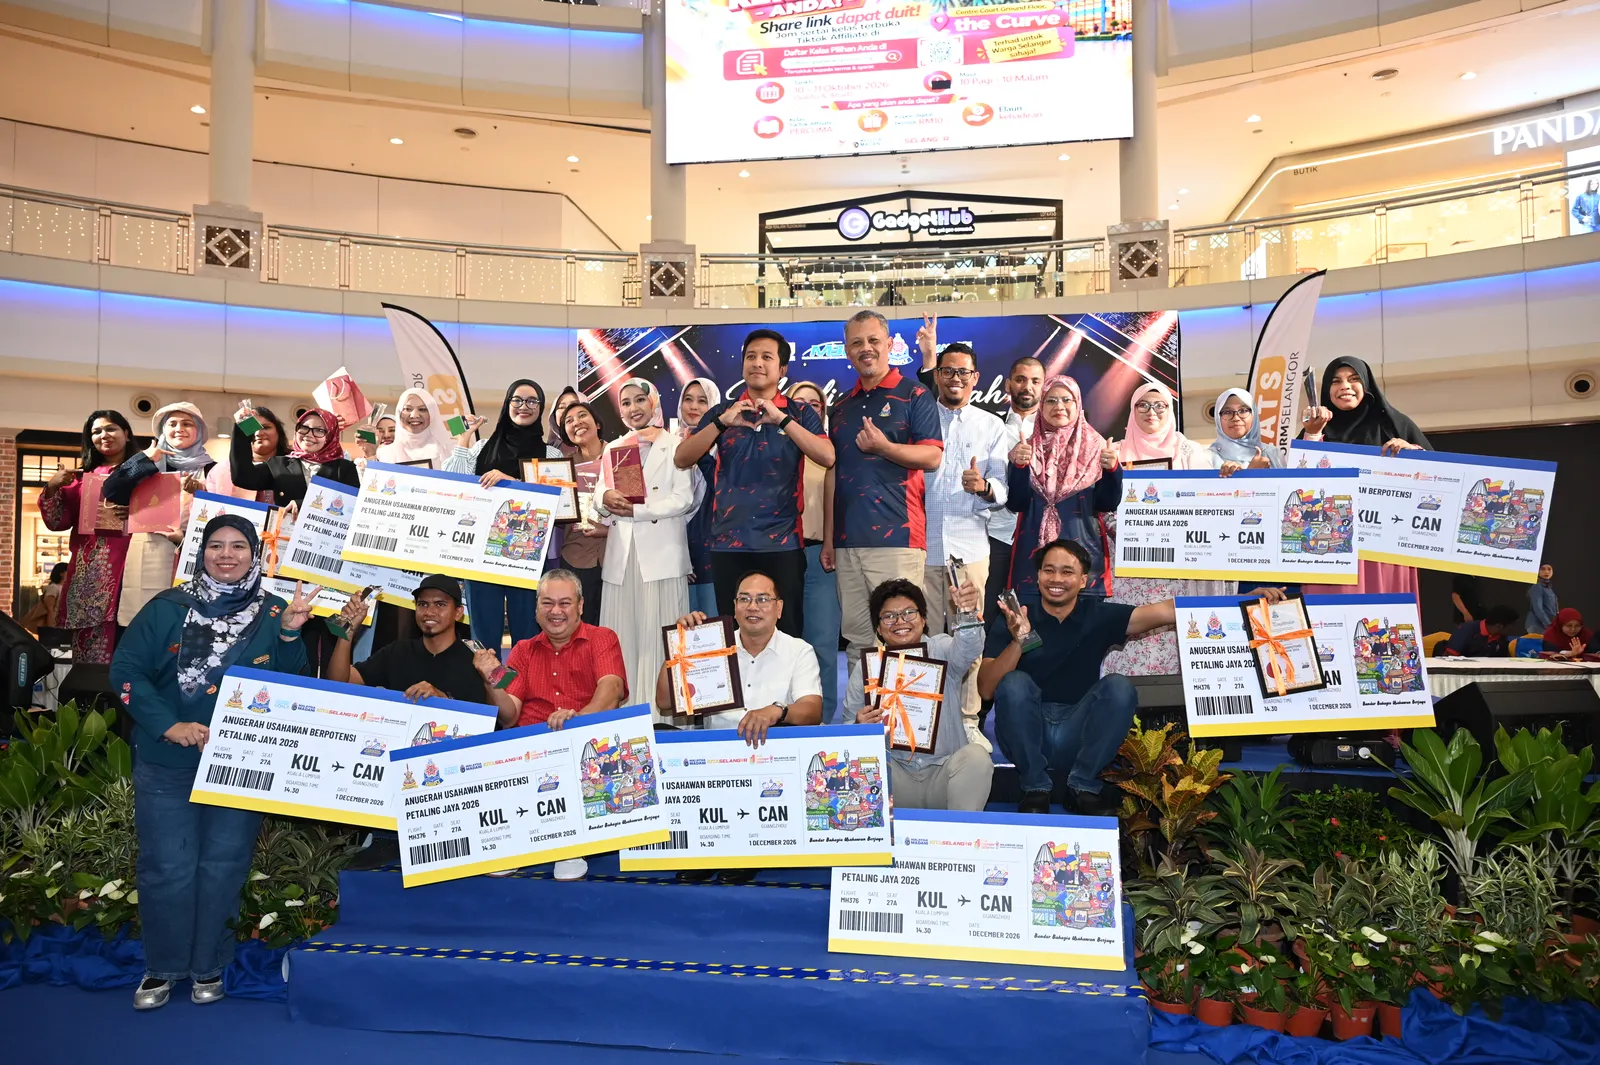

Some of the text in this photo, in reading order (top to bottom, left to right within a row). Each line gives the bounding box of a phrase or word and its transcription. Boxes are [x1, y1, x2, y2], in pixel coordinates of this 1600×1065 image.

[769, 0, 842, 18] ANDA!
[760, 5, 920, 34] Share link dapat duit!
[954, 13, 1060, 32] the Curve
[776, 21, 900, 39] Jom sertai kelas terbuka
[797, 35, 827, 44] Tiktok
[831, 32, 868, 41] Affiliate
[994, 34, 1043, 46] Terhad untuk
[784, 49, 808, 57] Daftar
[809, 47, 829, 55] Kelas
[831, 45, 856, 53] Pilihan
[857, 44, 878, 52] Anda
[992, 40, 1052, 54] Warga Selangor
[1010, 49, 1036, 58] sahaja!
[863, 100, 880, 108] yang
[916, 97, 940, 105] dapat?
[1494, 113, 1600, 155] PAND
[1293, 166, 1318, 175] BUTIK
[873, 209, 973, 230] GadgetHub
[1368, 487, 1412, 499] BERPOTENSI
[364, 497, 455, 516] ANUGERAH USAHAWAN BERPOTENSI
[1125, 508, 1158, 516] ANUGERAH
[307, 513, 339, 528] ANUGERAH
[360, 507, 415, 521] PETALING JAYA 2026
[1358, 509, 1442, 532] KUL CAN
[303, 523, 332, 537] PETALING
[409, 525, 475, 545] KUL CAN
[1186, 531, 1264, 544] KUL CAN
[1400, 542, 1429, 552] DECEMBER
[1189, 645, 1252, 655] ANUGERAH USAHA
[1191, 660, 1256, 670] PETALING JAYA 202
[1324, 670, 1342, 686] AN
[222, 716, 357, 742] ANUGERAH USAHAWAN BERPOTENSI
[218, 729, 299, 748] PETALING JAYA 2026
[212, 752, 232, 760] MH376
[291, 753, 384, 782] KUL CAN
[284, 786, 300, 794] 14.30
[405, 776, 529, 806] ANUGERAH USAHAWAN BERPOTENSI
[666, 779, 752, 790] USAHAWAN BERPOTENSI
[339, 794, 384, 806] DECEMBER 2026
[665, 795, 700, 805] JAYA 2026
[406, 800, 480, 820] PETALING JAYA 2026
[479, 797, 567, 828] KUL CAN
[700, 805, 788, 823] KUL CAN
[408, 832, 426, 840] MH376
[533, 829, 576, 842] DECEMBER 2026
[895, 860, 975, 872] AHAWAN BERPOTENSI
[842, 873, 920, 885] PETALING JAYA 2026
[917, 890, 1012, 913] KUL CAN
[972, 931, 1004, 939] DECEMBER
